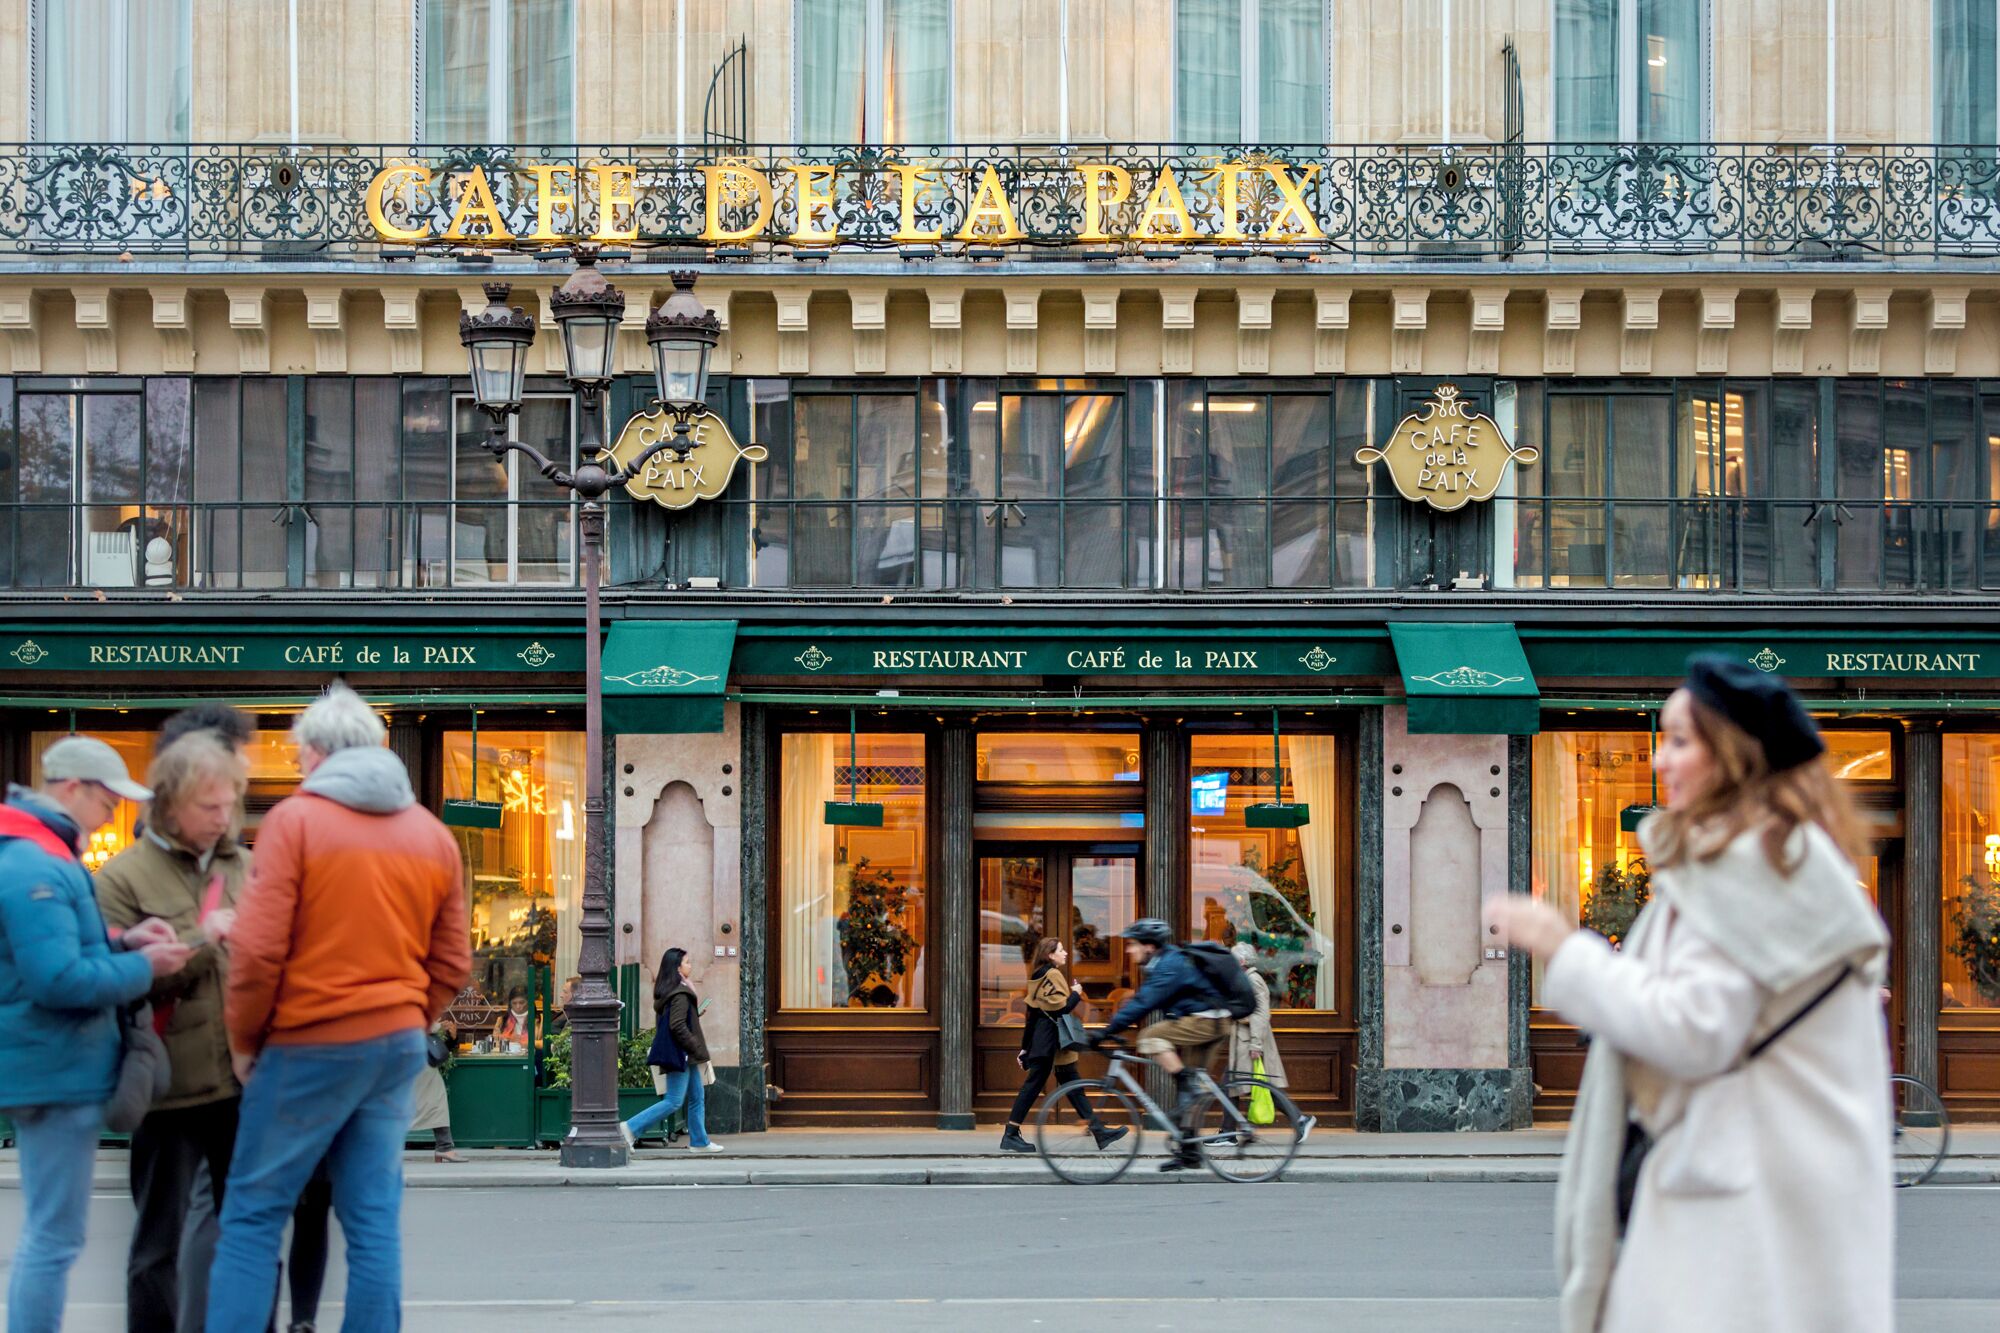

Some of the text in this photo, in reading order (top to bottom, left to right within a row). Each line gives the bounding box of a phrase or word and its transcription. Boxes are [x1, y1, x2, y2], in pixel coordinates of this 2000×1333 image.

[365, 164, 1328, 241] CAFE DE LA PAIX
[639, 422, 711, 446] CAE
[1411, 424, 1481, 451] CAFE
[1425, 449, 1469, 466] de la
[645, 465, 707, 489] PAIX
[1417, 468, 1480, 492] PAIX
[89, 642, 476, 664] RESTAURANT CAFÉ de la PAIX
[873, 646, 1258, 669] RESTAURANT CAFÉ de la PAIX
[1826, 653, 1980, 672] RESTAURANT
[460, 1012, 481, 1021] PAIX
